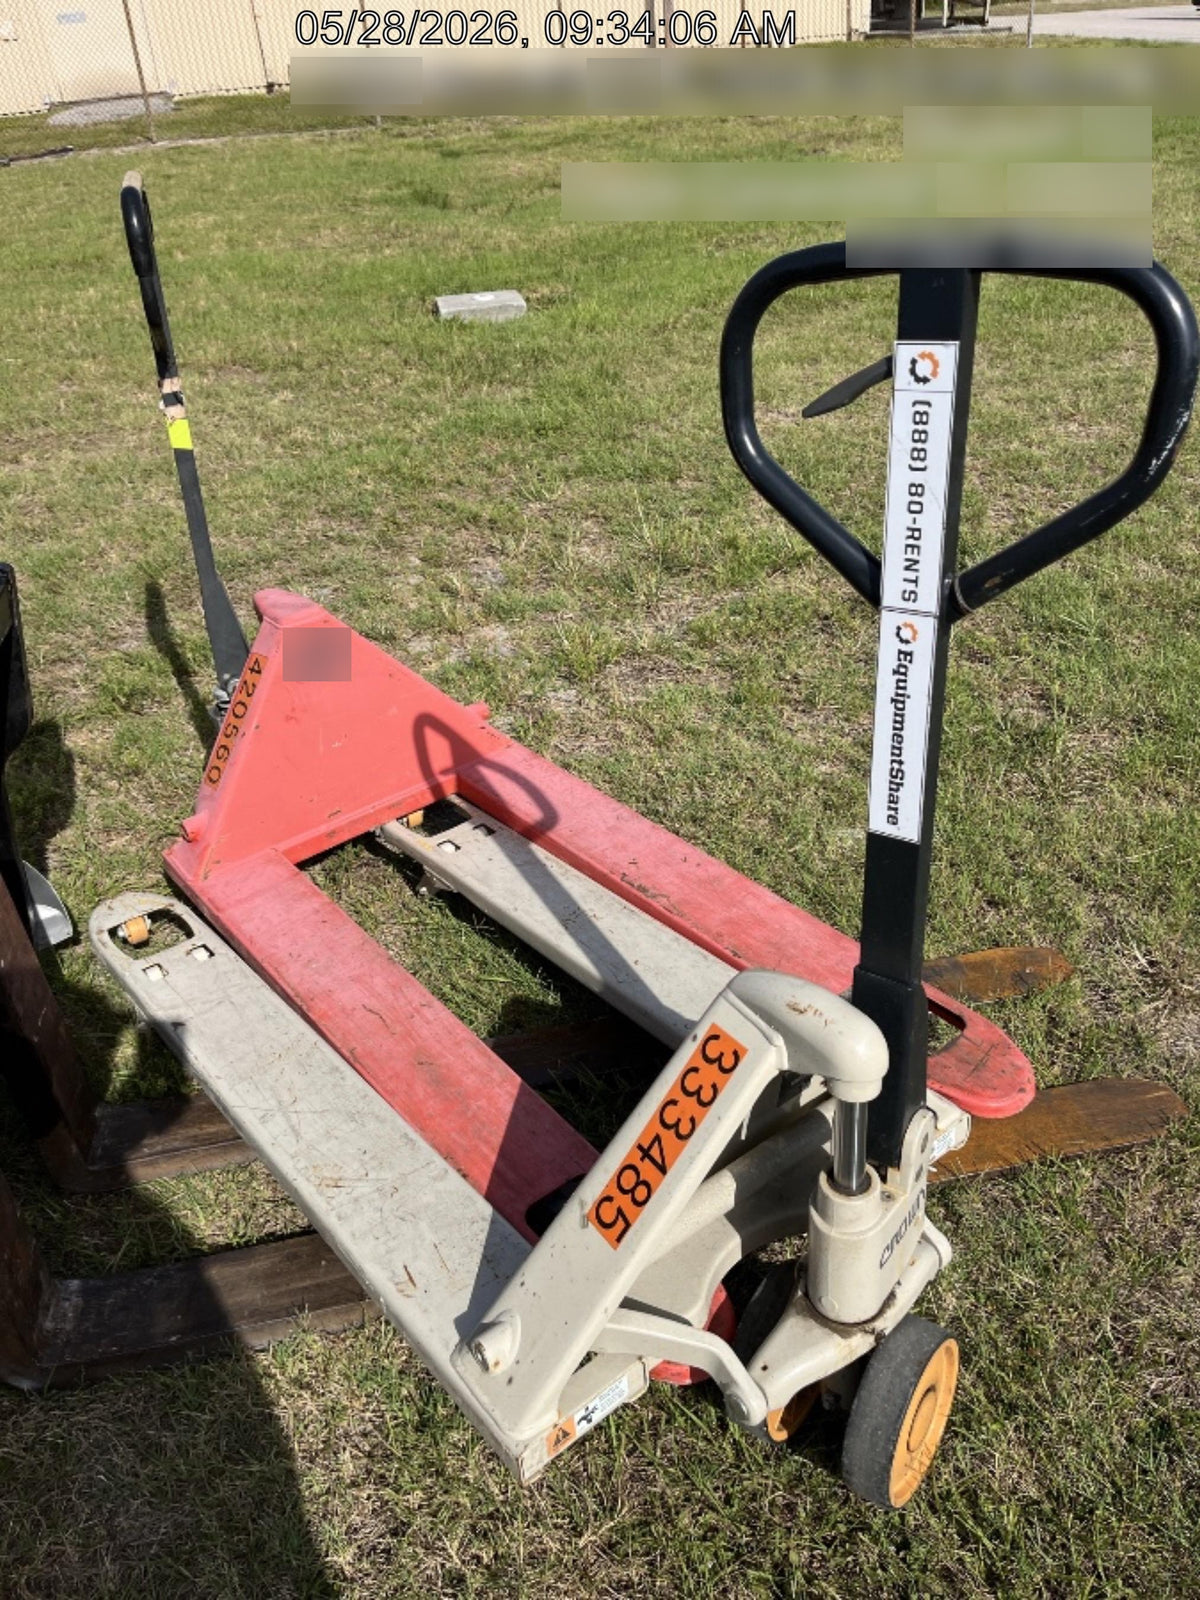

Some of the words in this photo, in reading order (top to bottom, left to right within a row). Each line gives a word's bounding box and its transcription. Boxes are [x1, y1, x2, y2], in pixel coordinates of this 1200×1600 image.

[907, 400, 932, 472] (888)
[901, 483, 925, 604] 80-RENTS
[206, 657, 262, 785] 420560
[886, 649, 914, 826] EquipmentShare
[595, 1034, 741, 1244] 333485
